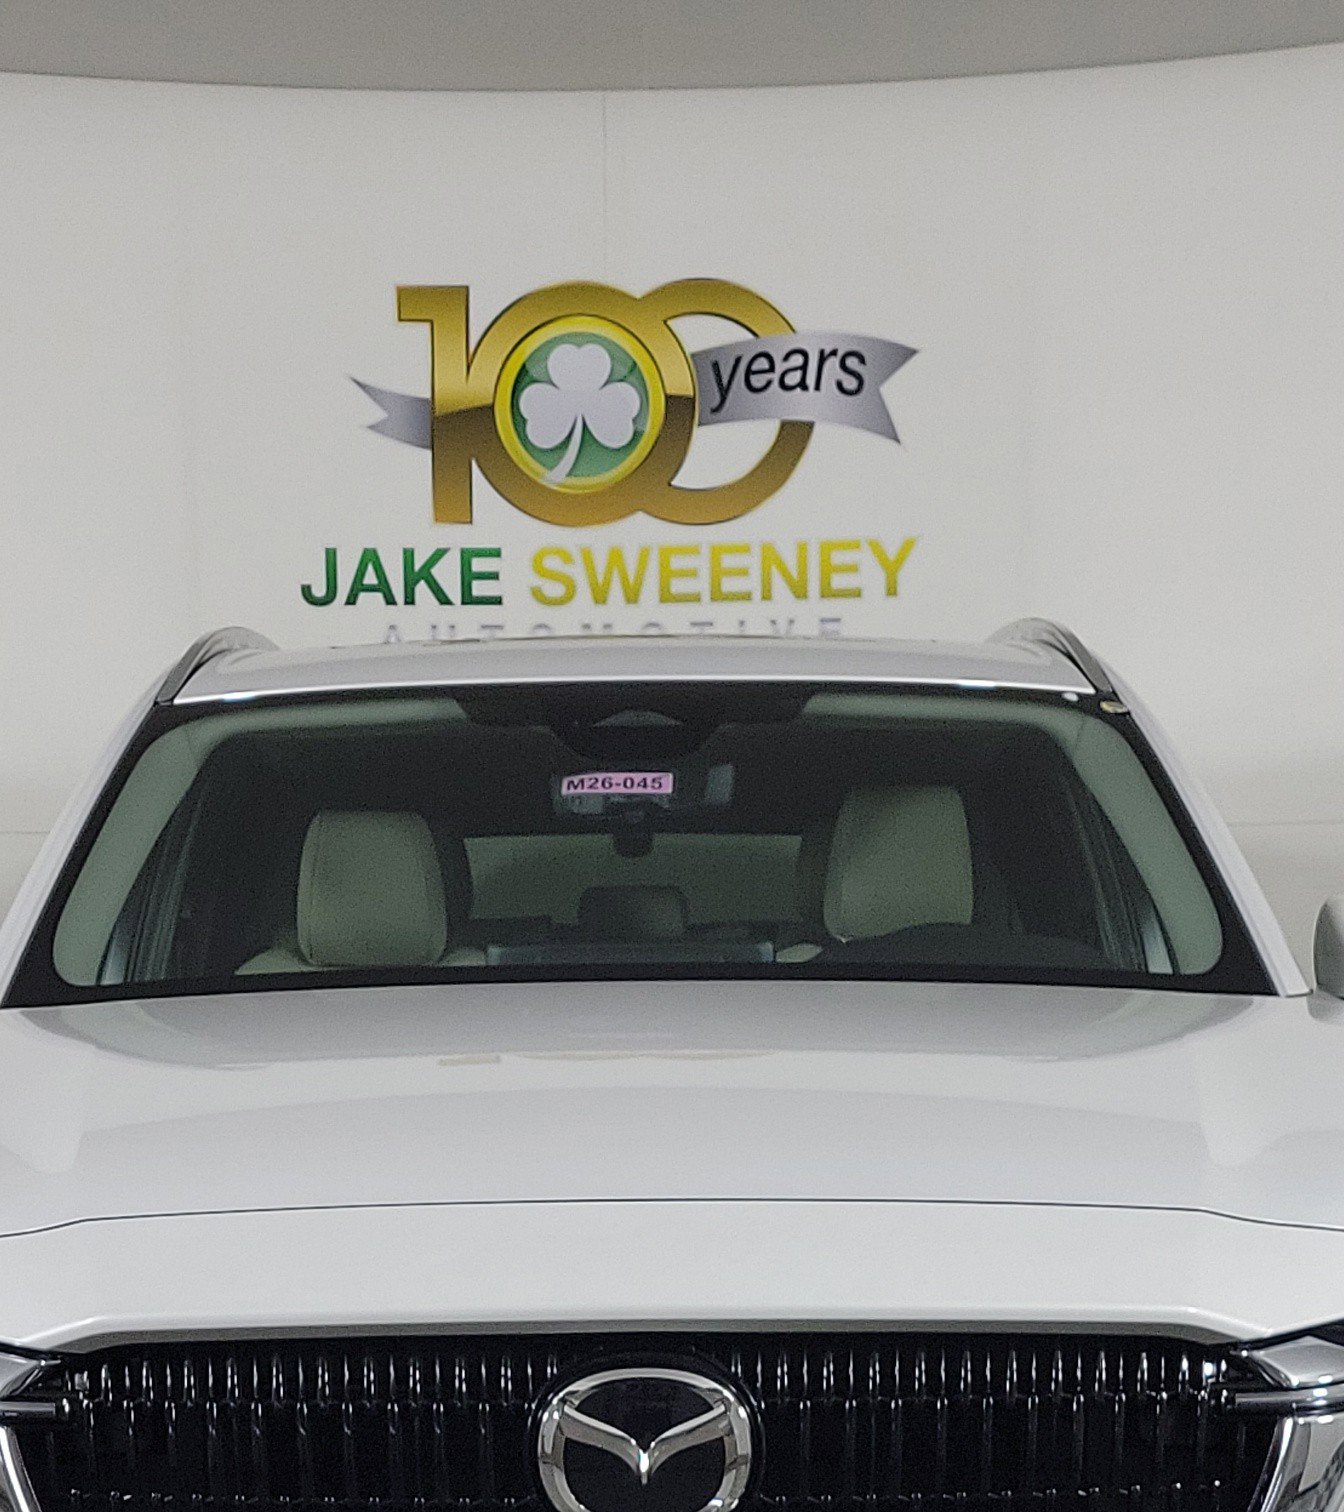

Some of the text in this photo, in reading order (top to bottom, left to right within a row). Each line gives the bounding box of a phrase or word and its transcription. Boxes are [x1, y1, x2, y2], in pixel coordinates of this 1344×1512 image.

[395, 278, 867, 526] 100 years
[301, 535, 918, 607] JAKE SWEENEY
[566, 776, 664, 792] M26-045
